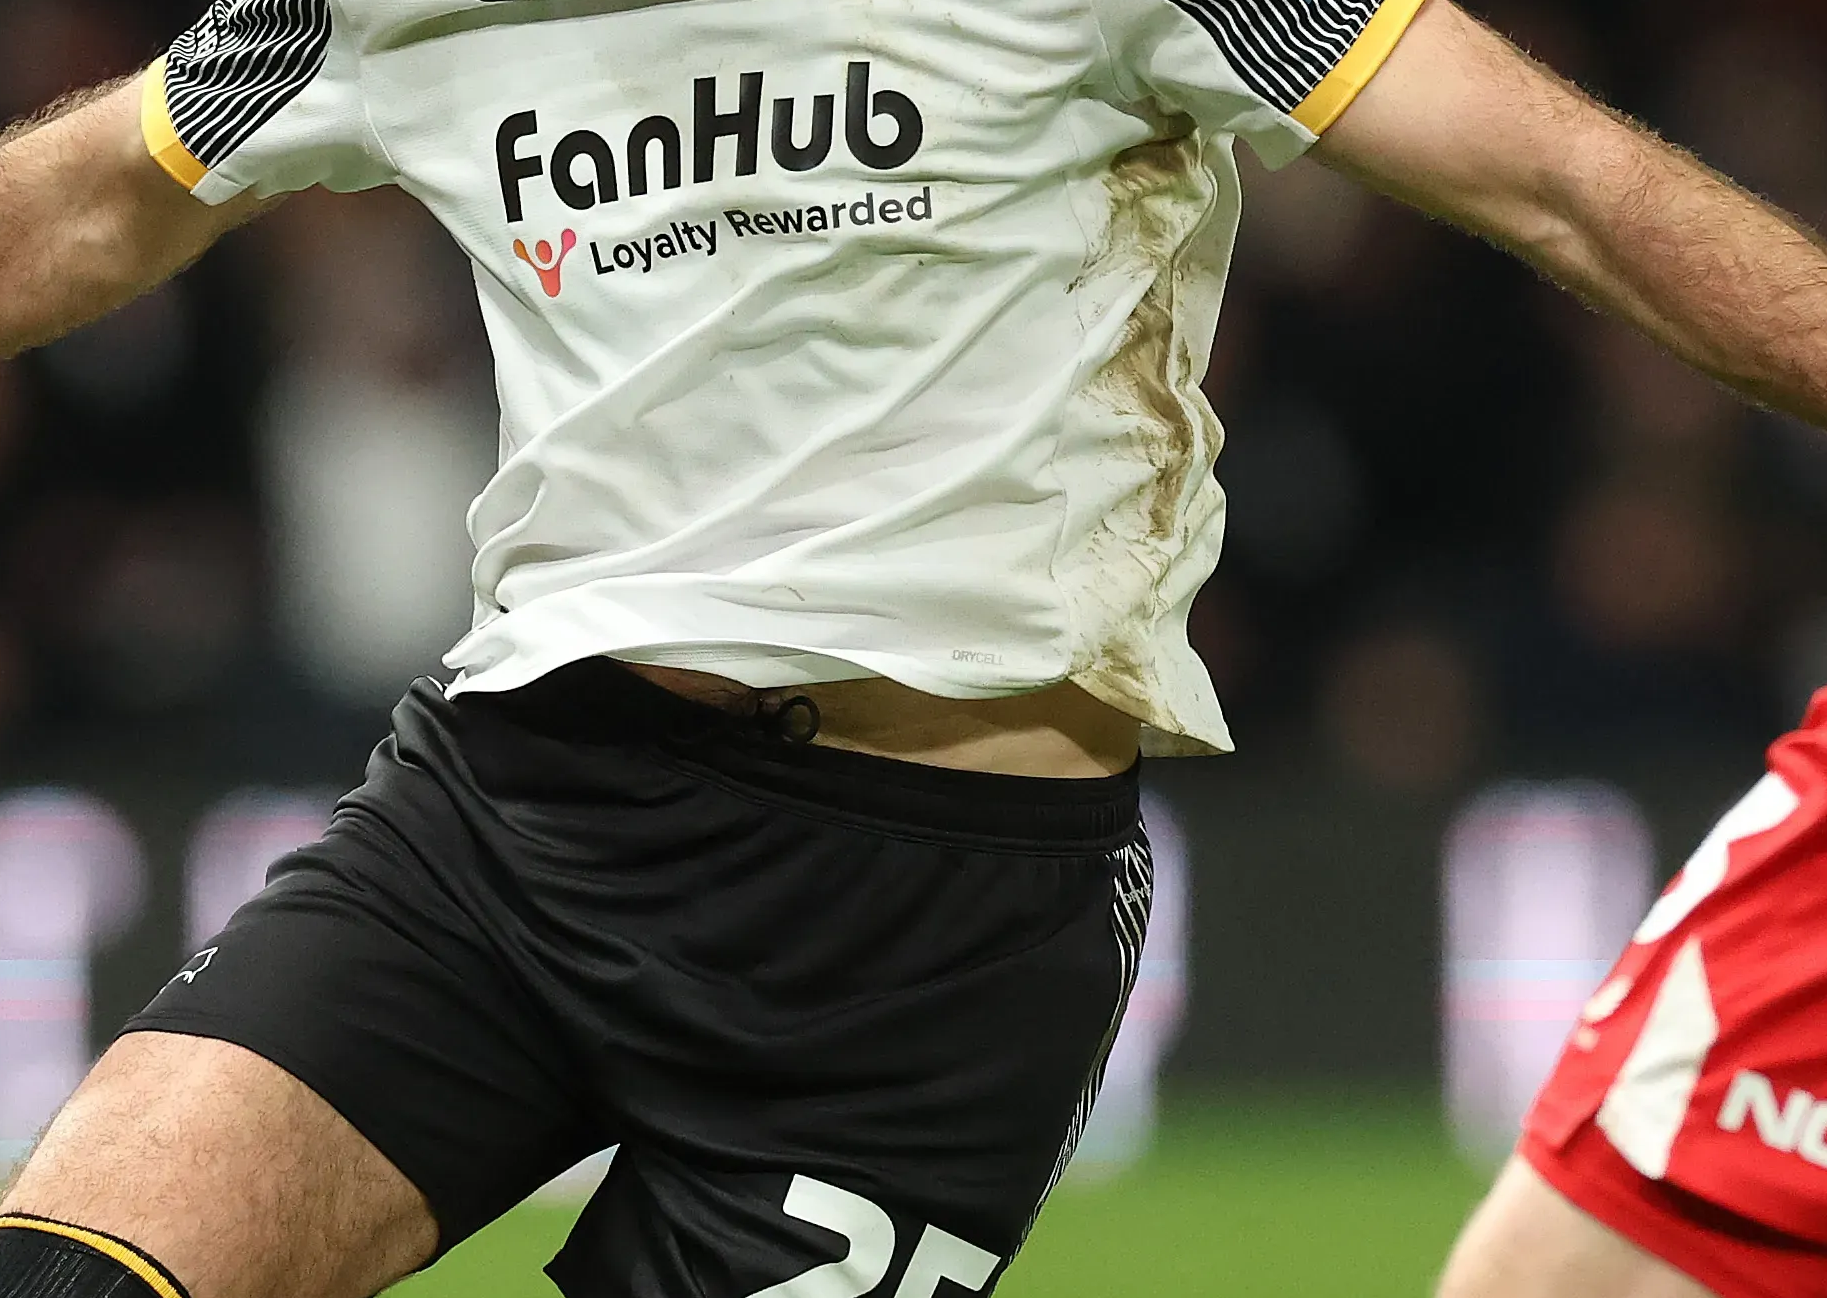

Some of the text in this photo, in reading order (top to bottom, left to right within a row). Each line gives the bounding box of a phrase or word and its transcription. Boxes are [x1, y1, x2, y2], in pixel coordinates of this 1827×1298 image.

[495, 61, 924, 224] FanHub
[590, 186, 933, 276] Loyalty Rewarded
[952, 649, 1004, 665] DRYCELL
